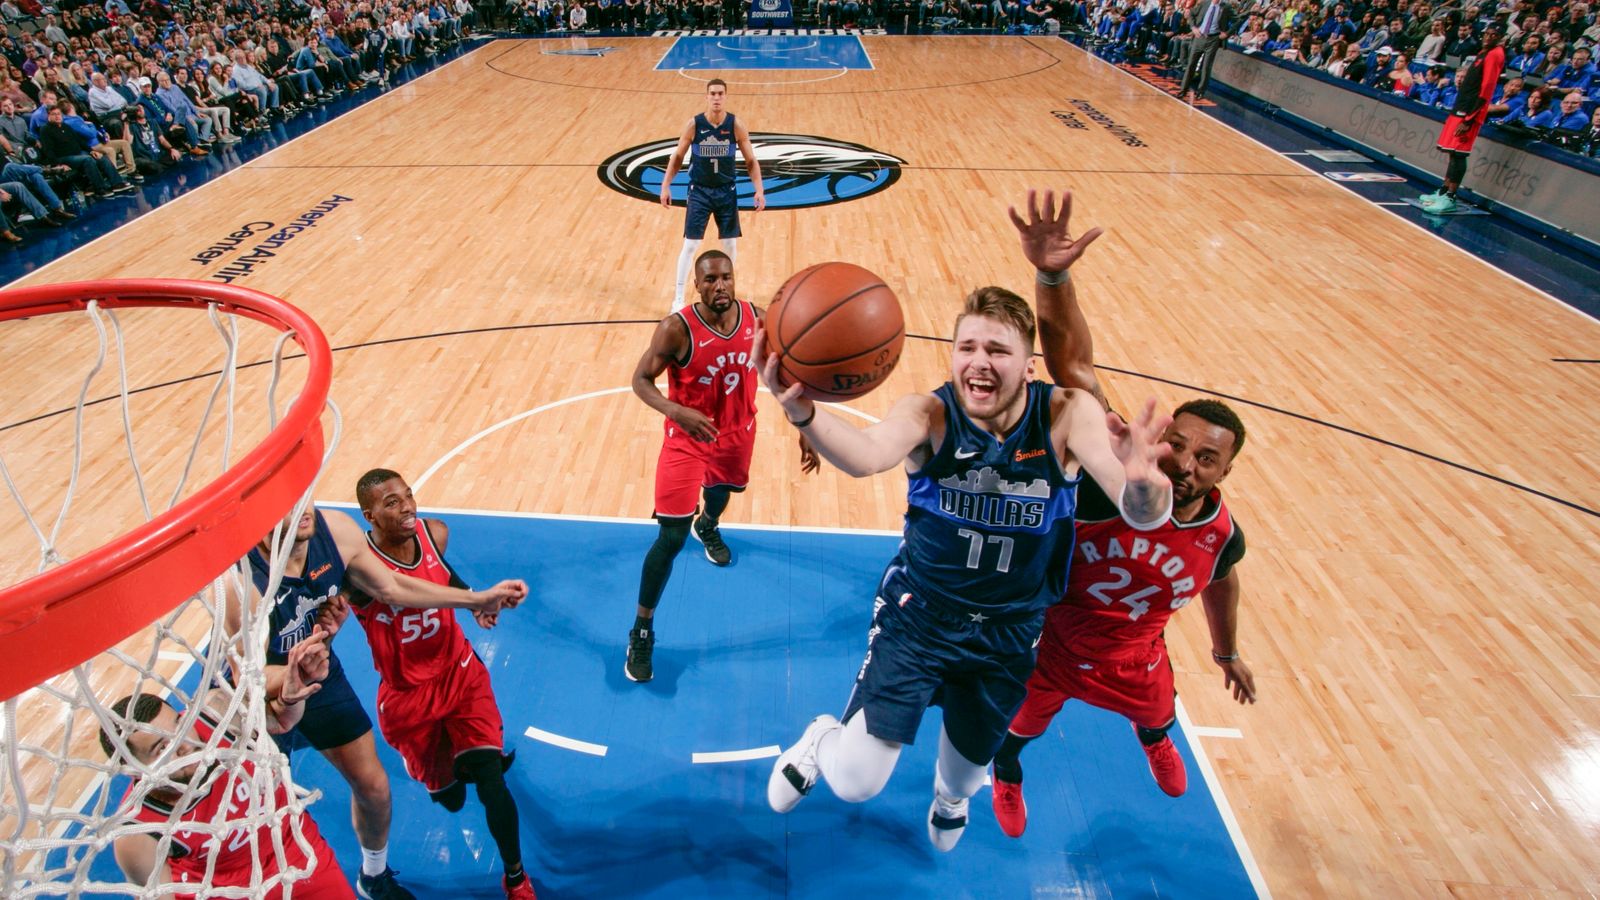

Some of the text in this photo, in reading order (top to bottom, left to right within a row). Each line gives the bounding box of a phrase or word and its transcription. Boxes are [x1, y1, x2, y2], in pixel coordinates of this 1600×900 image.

[1050, 110, 1089, 131] Center
[699, 145, 730, 157] DALLAS
[1472, 148, 1539, 197] enters
[190, 221, 275, 265] Center
[724, 372, 740, 395] 9
[939, 488, 1046, 529] DALLAS
[957, 528, 1015, 573] 77
[1079, 536, 1195, 610] RAPTORS
[1086, 566, 1163, 622] 24
[401, 607, 441, 644] 55
